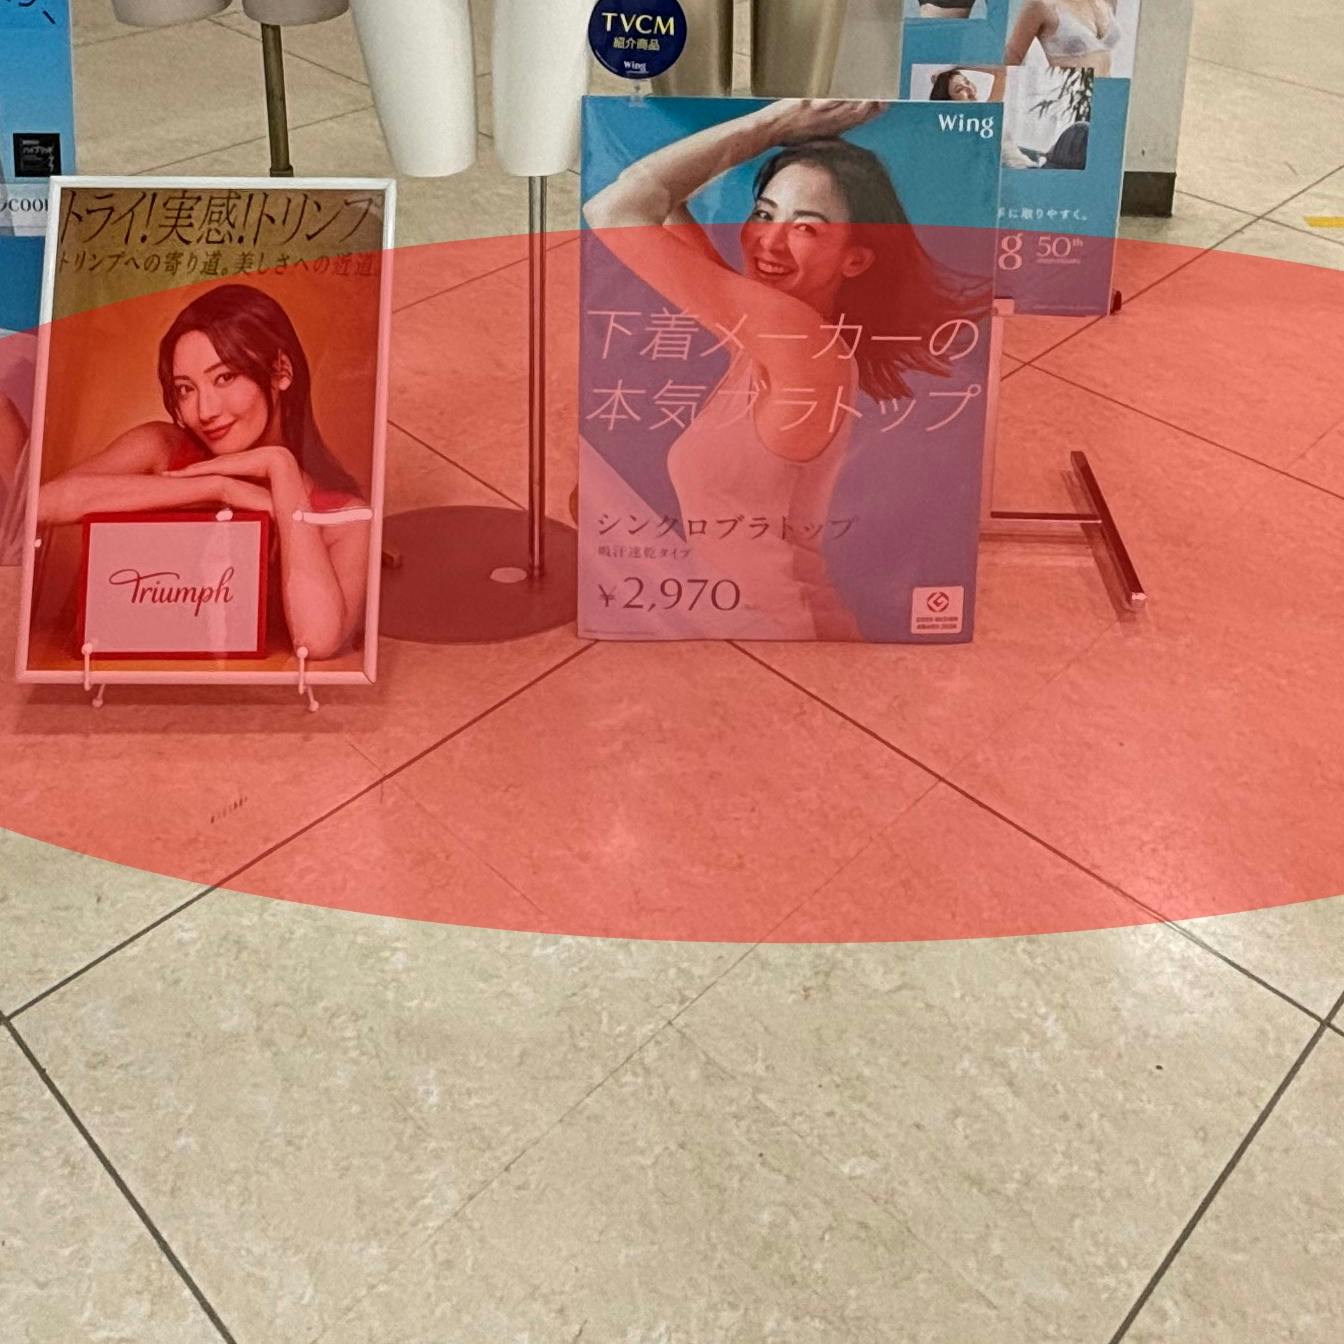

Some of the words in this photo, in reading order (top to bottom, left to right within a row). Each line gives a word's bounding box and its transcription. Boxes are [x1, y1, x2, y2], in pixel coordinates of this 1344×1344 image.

[601, 12, 675, 36] TVCM
[937, 112, 995, 139] Wing
[586, 307, 980, 361] 下着メーカーの
[585, 379, 982, 434] 本気ブラトップ
[109, 567, 234, 617] Triumph
[597, 576, 741, 612] ¥2,970
